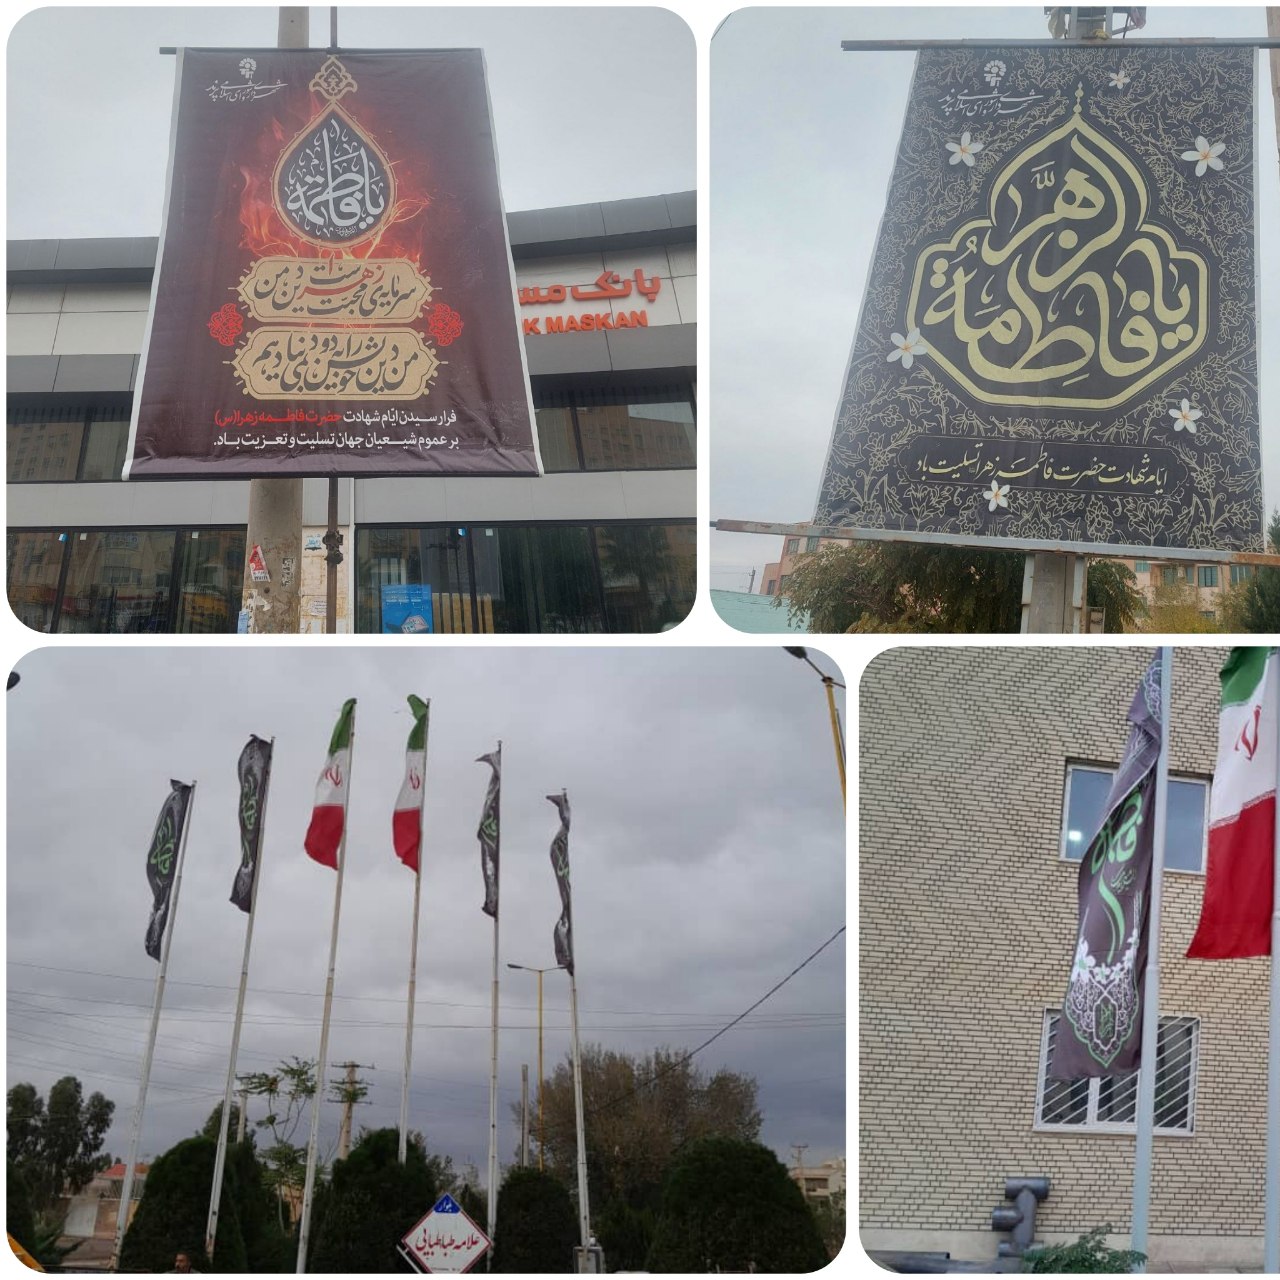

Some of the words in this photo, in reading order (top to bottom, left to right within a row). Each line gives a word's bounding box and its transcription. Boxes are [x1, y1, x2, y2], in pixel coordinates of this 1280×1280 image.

[571, 268, 661, 303] بانک
[545, 310, 648, 334] MASKAN
[305, 410, 341, 427] حضرت
[343, 409, 380, 424] شهادت
[296, 432, 335, 449] تسلیت
[335, 432, 364, 448] جهان
[419, 436, 447, 450] عموم
